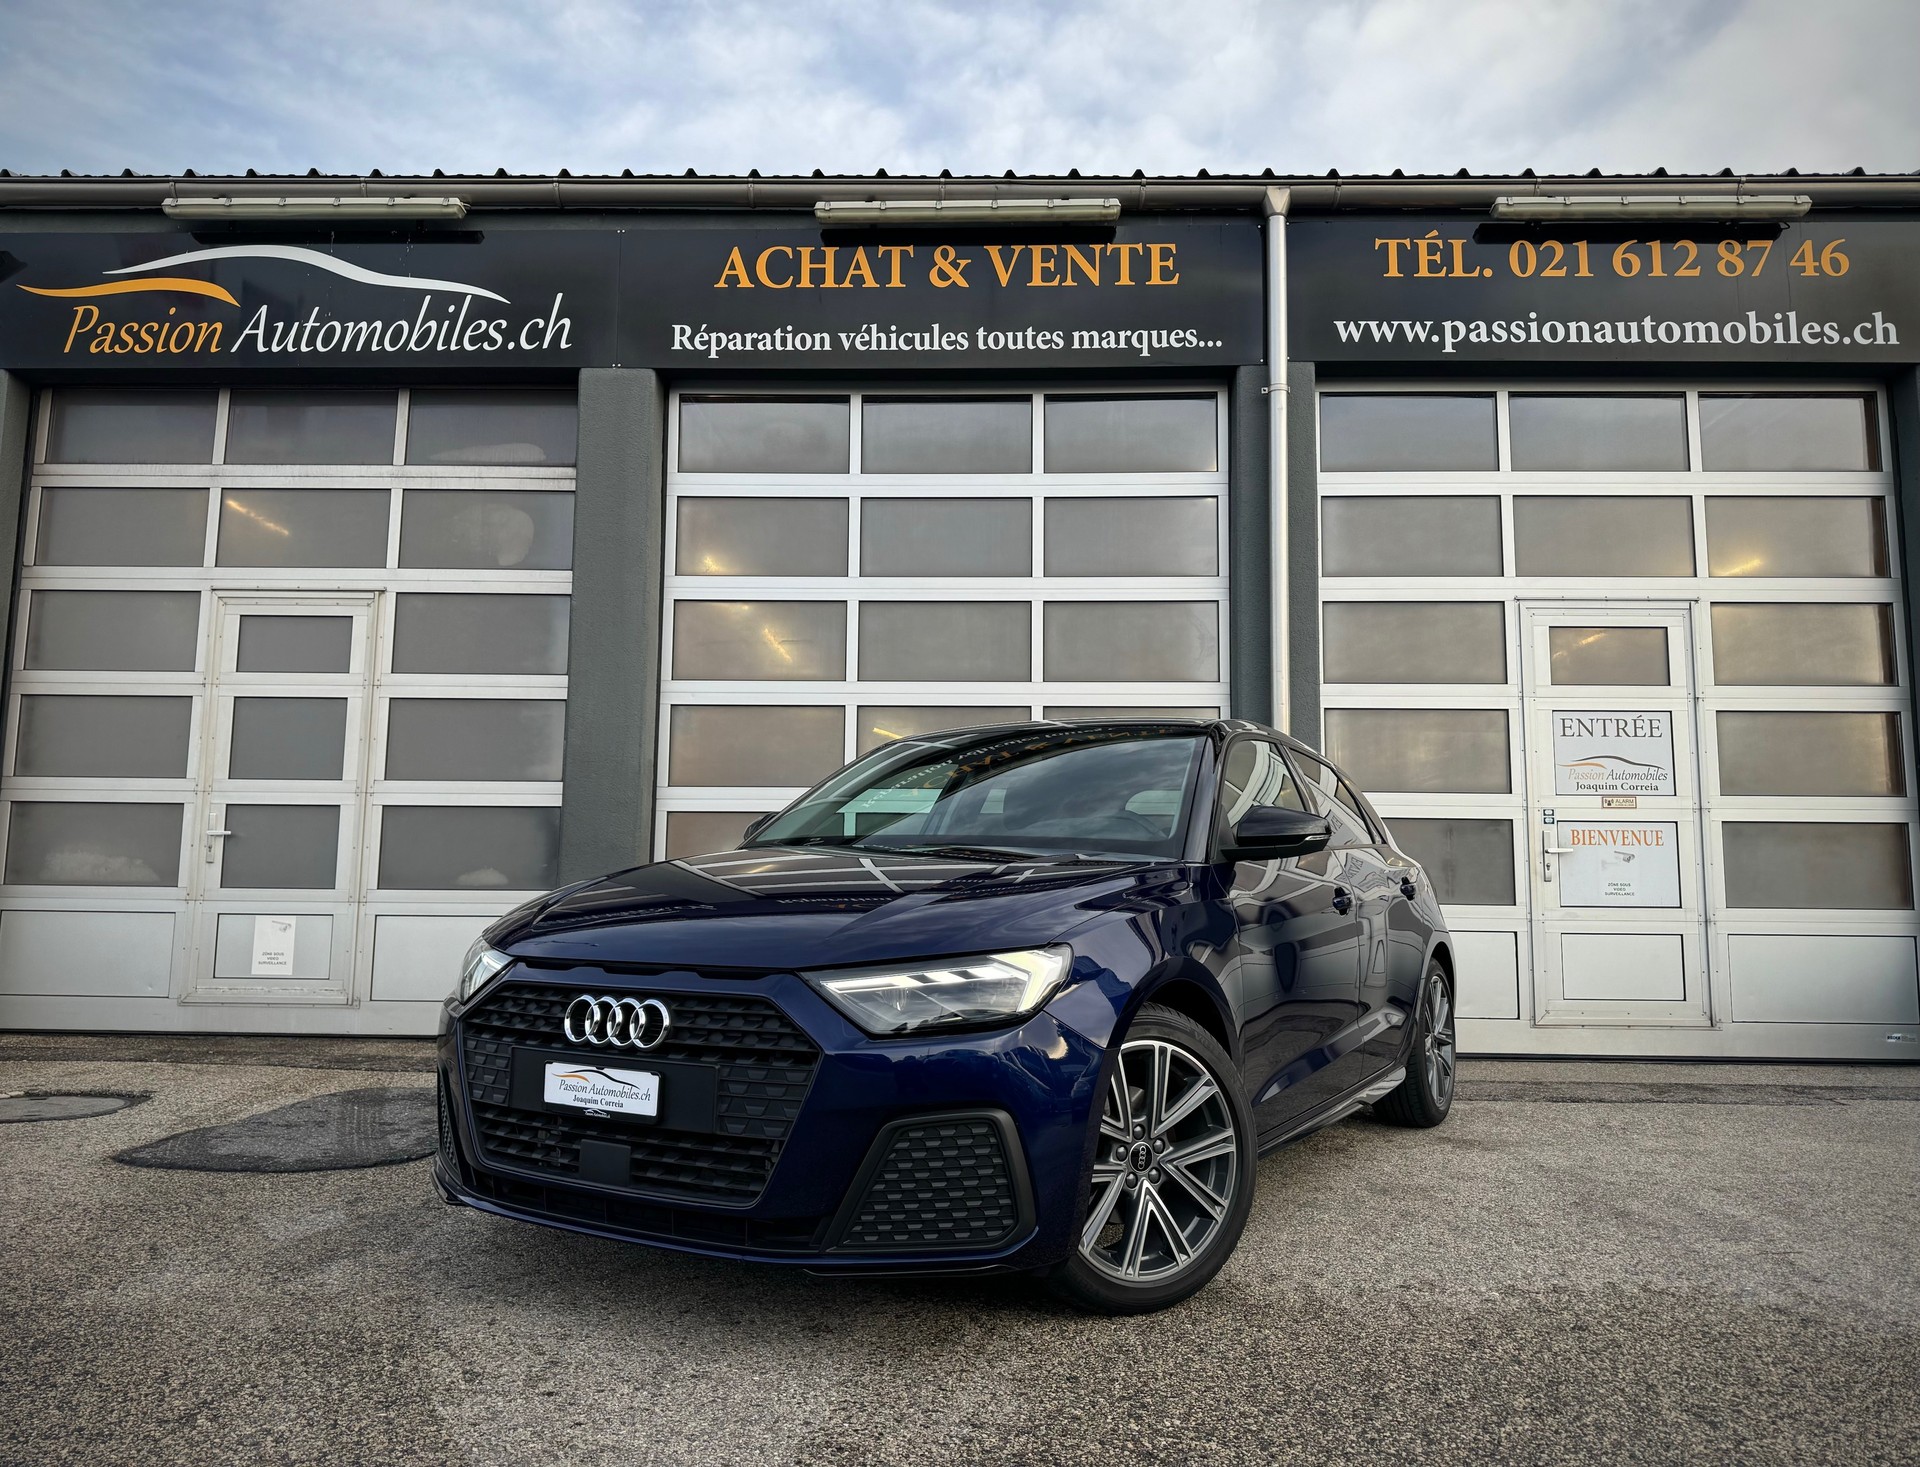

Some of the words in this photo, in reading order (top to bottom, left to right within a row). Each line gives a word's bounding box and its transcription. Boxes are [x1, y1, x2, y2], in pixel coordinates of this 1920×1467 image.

[714, 245, 914, 289] ACHAT
[929, 245, 971, 289] &
[984, 243, 1180, 287] VENTE
[1375, 230, 1493, 278] TÉL.
[1509, 239, 1595, 278] 021
[1612, 239, 1702, 278] 612
[1717, 239, 1773, 278] 87
[1791, 239, 1850, 278] 46
[64, 305, 222, 354] Passion
[230, 292, 572, 353] Automobiles.ch
[1333, 311, 1900, 353] www.passionautomobiles.ch
[671, 324, 832, 358] Réparation
[838, 323, 969, 351] véhicules
[976, 326, 1065, 351] toutes
[1071, 328, 1223, 357] marques...
[1560, 714, 1663, 738] ENTRÉE
[1568, 768, 1605, 781] Passion
[1606, 767, 1668, 781] Automobiles
[1576, 782, 1618, 792] Joaquim
[1621, 782, 1659, 791] Correia
[1570, 829, 1664, 846] BIENVENUE
[559, 1079, 587, 1095] Passion
[588, 1083, 651, 1101] Automobiles.ch
[573, 1094, 599, 1105] Joaquim
[600, 1096, 624, 1108] Correia
